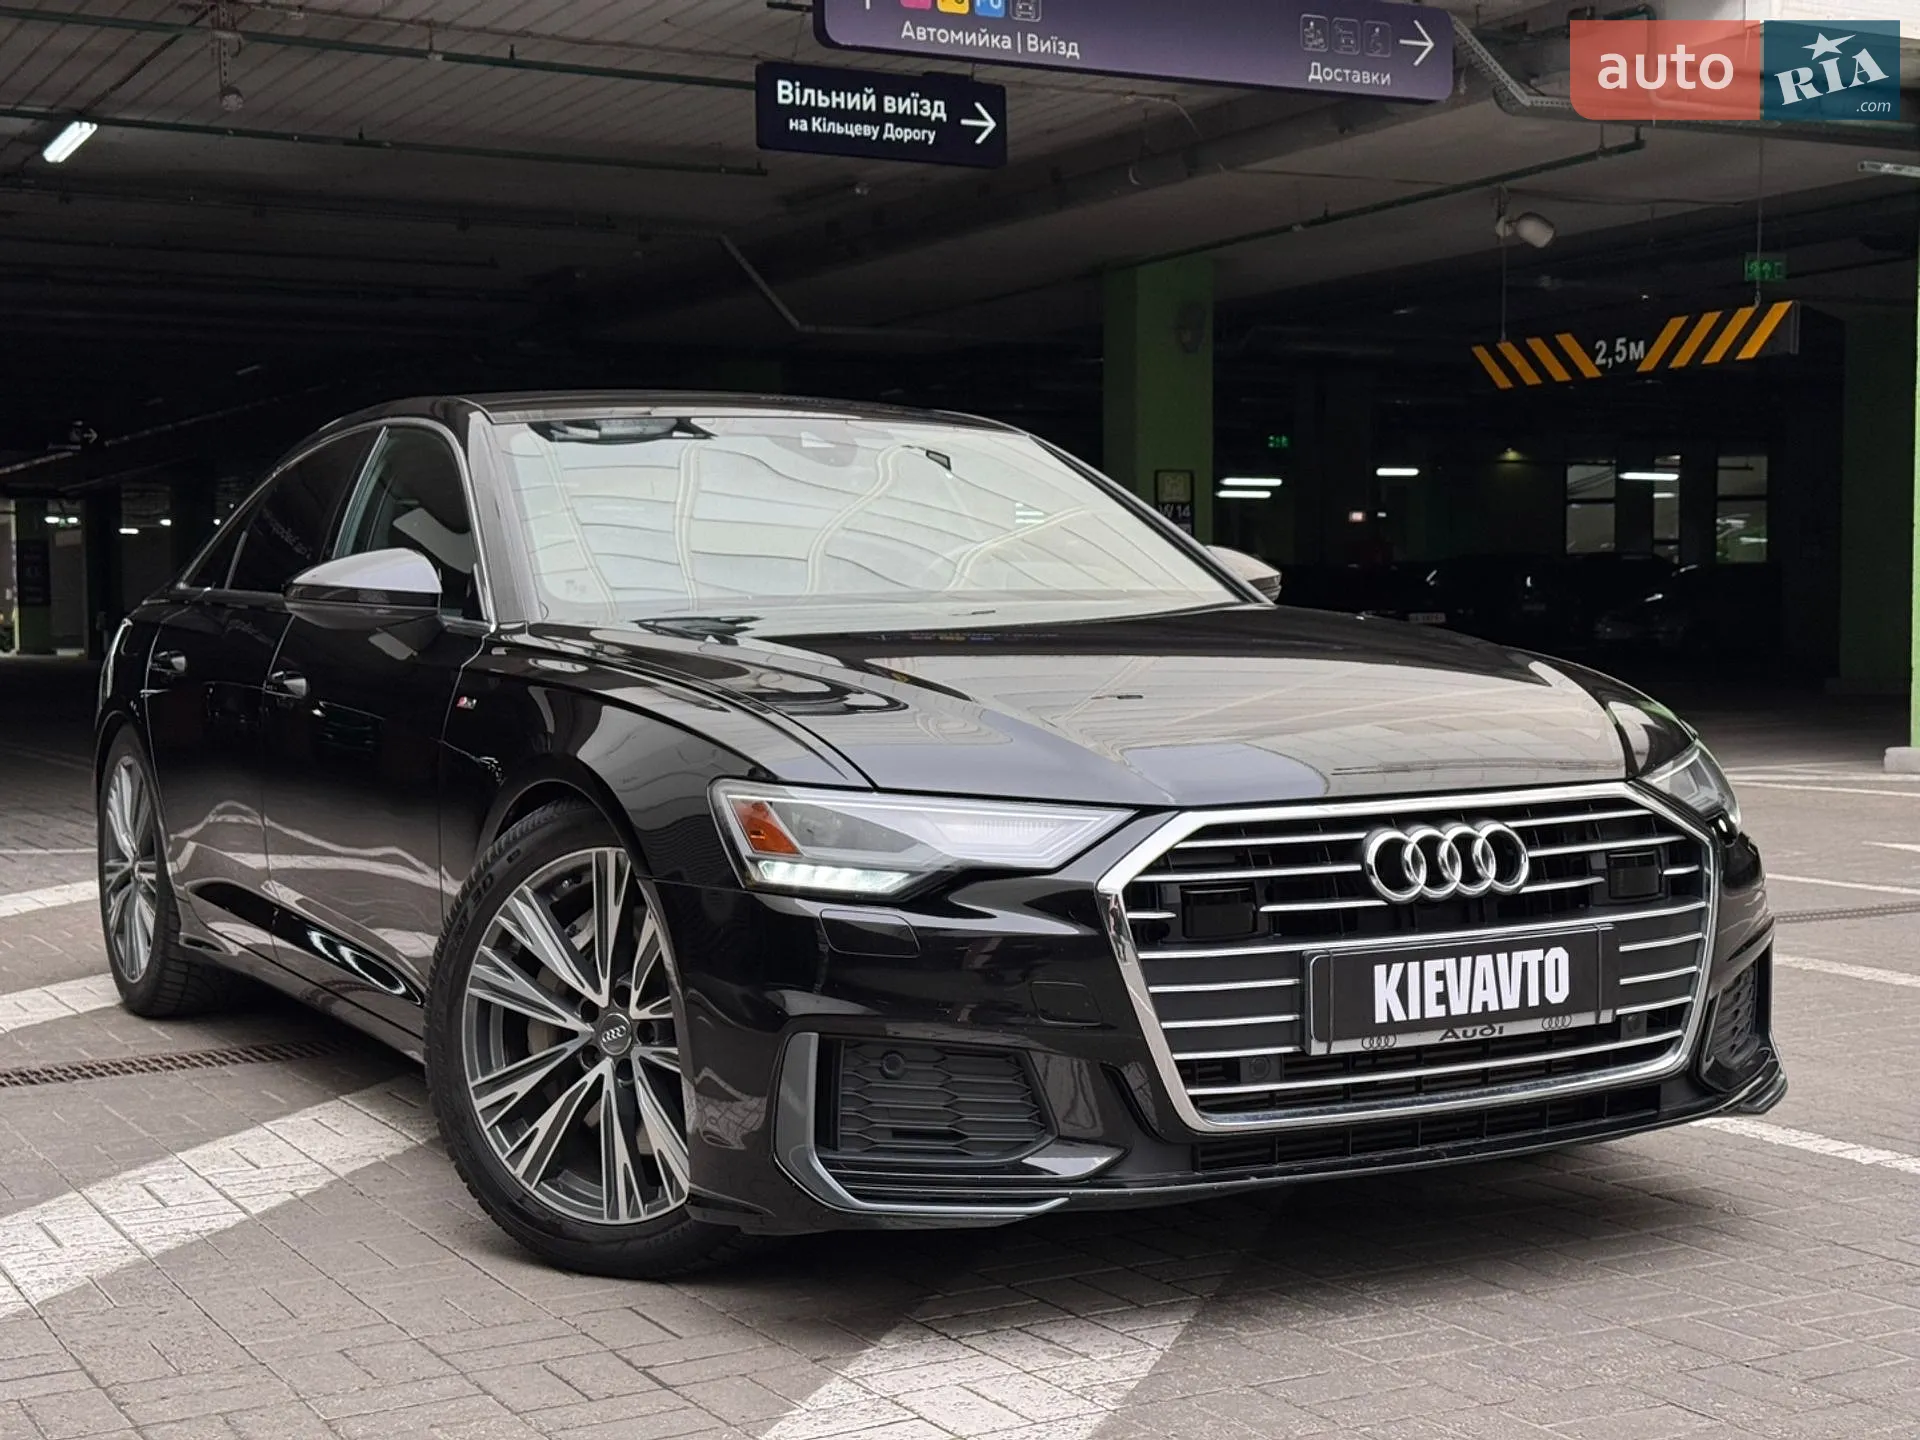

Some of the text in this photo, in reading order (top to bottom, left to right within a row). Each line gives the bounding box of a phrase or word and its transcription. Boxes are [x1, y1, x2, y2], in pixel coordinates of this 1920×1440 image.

[901, 20, 1012, 50] Автомийка
[1026, 33, 1081, 60] Виїзд
[1308, 61, 1392, 86] Доставки
[776, 79, 948, 123] Вільний виїзд
[788, 116, 937, 145] на Кільцеву Дорогу
[1374, 946, 1570, 1024] KIEVAVTO
[1438, 1024, 1505, 1043] Audi
